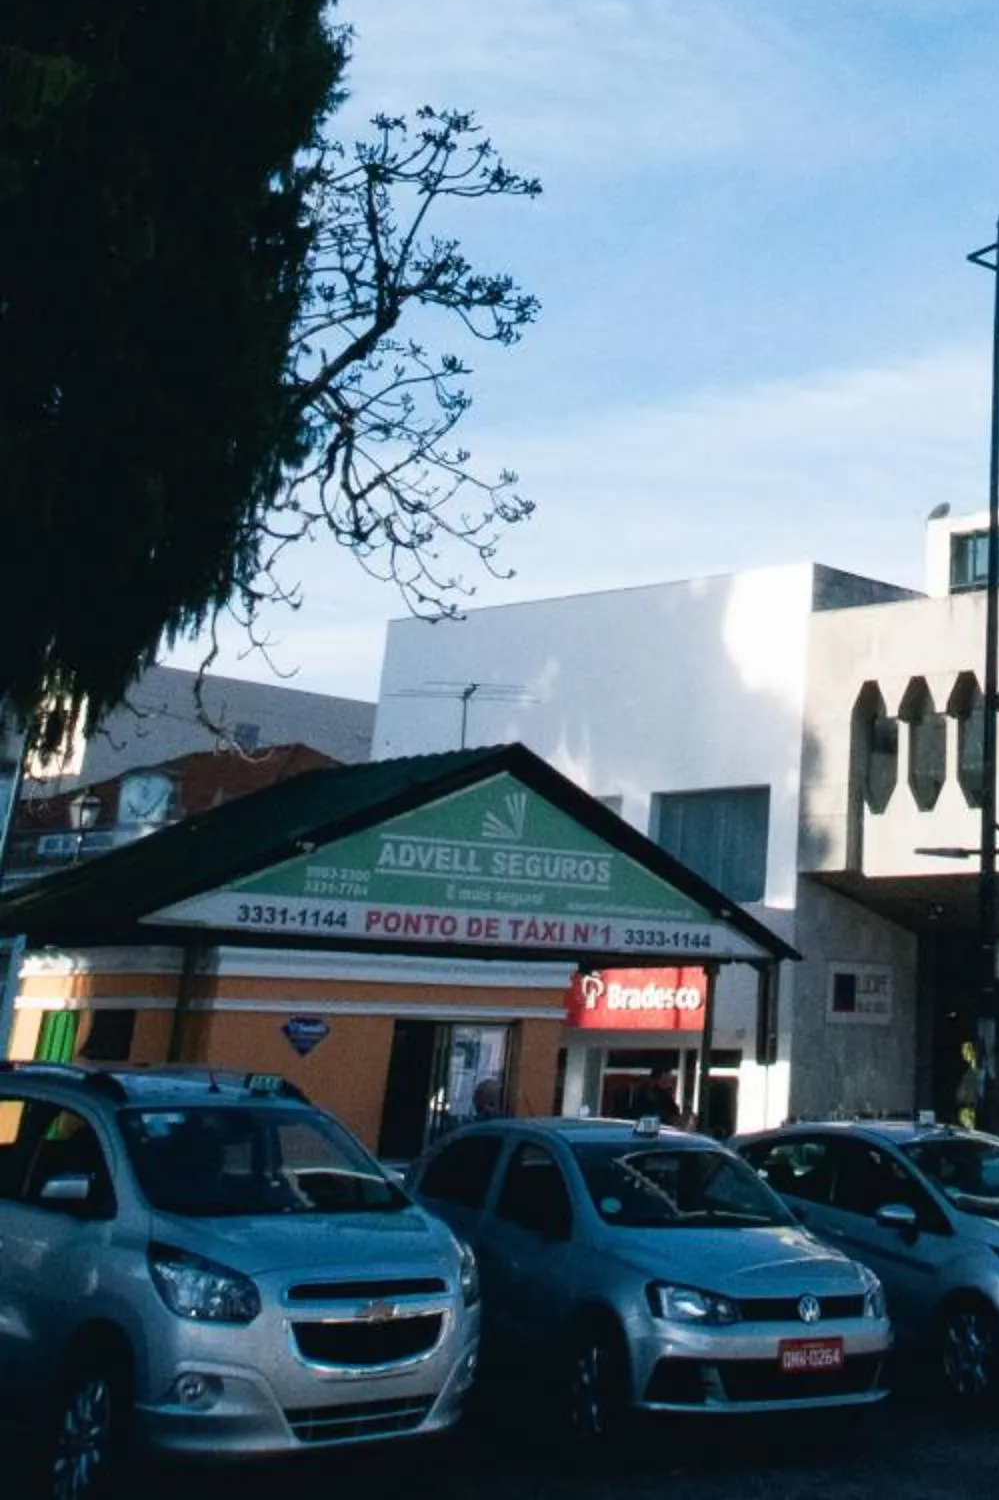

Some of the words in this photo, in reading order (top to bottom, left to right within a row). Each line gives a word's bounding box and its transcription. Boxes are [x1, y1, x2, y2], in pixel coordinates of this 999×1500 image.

[377, 841, 481, 874] ADVELL
[491, 851, 611, 883] SEGUROS
[236, 902, 348, 929] 3331-1144
[364, 909, 458, 936] PONTO
[466, 916, 500, 939] DE
[623, 928, 712, 949] 3333-1144
[606, 981, 701, 1011] Bradesco
